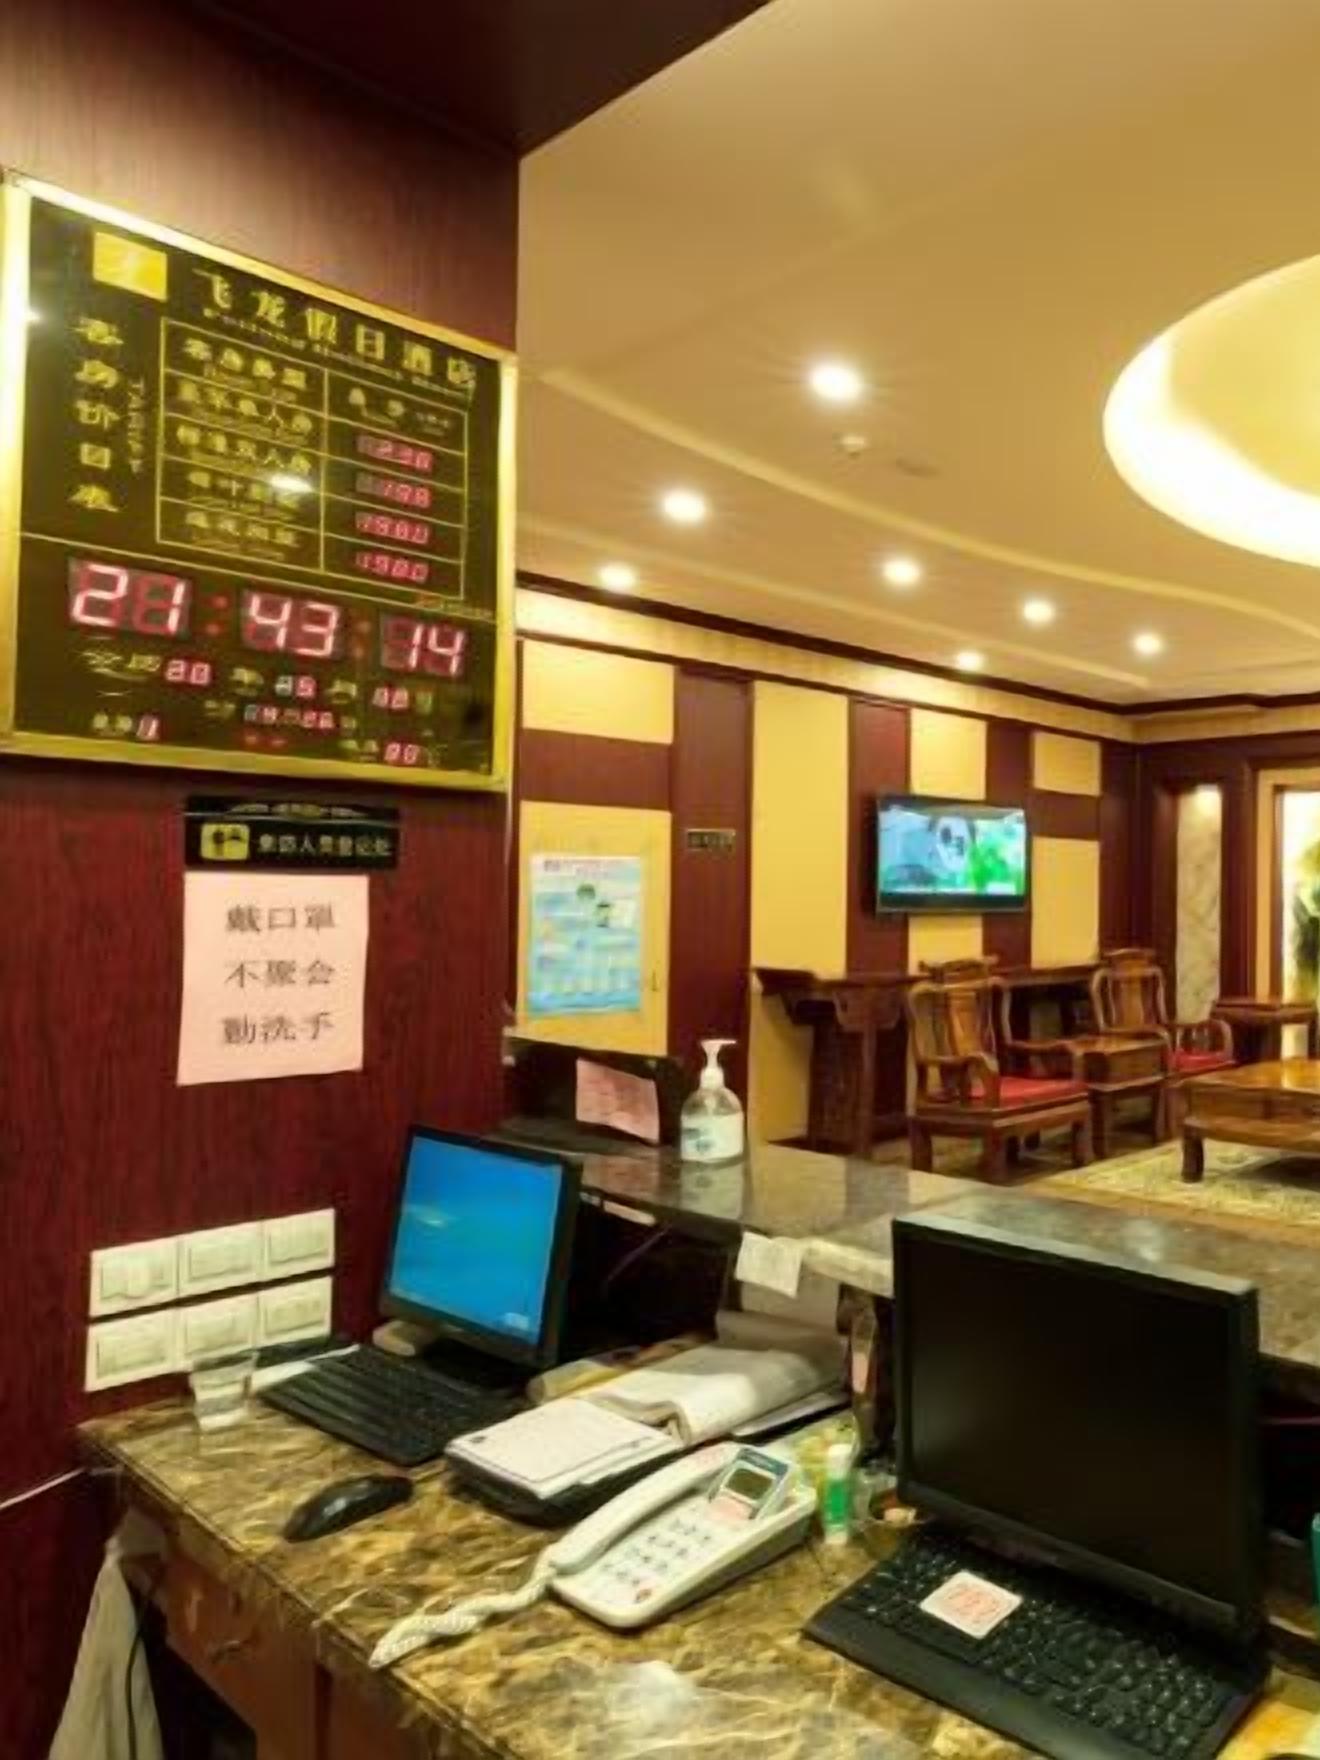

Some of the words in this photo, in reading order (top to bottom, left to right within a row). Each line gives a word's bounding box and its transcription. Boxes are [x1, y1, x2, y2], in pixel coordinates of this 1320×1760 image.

[226, 904, 336, 935] 戴口罩
[224, 958, 336, 990] 不聚会
